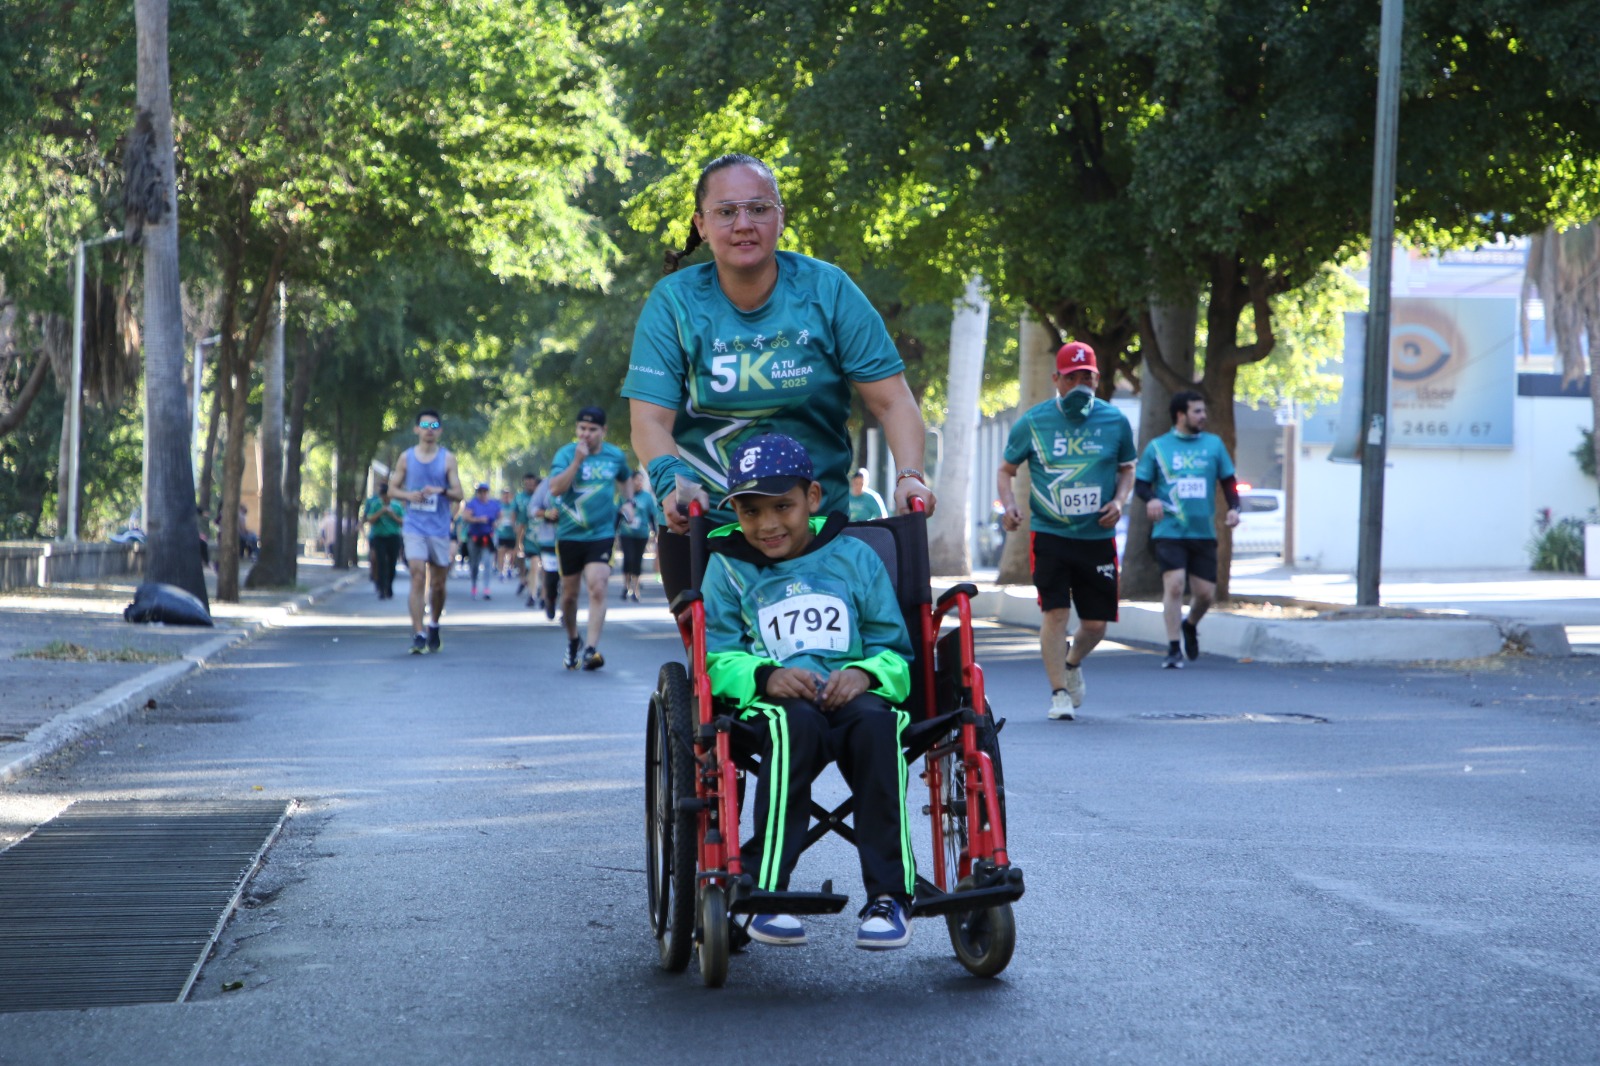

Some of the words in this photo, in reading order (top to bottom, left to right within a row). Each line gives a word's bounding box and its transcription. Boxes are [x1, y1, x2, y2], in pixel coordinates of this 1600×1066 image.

[710, 351, 775, 393] 5K
[771, 361, 779, 370] A
[781, 360, 795, 369] TU
[771, 365, 813, 379] MANERA
[781, 377, 808, 389] 2025
[1052, 437, 1085, 457] 5K
[1064, 493, 1097, 507] 0512
[785, 583, 801, 597] 5K
[768, 606, 842, 641] 1792
